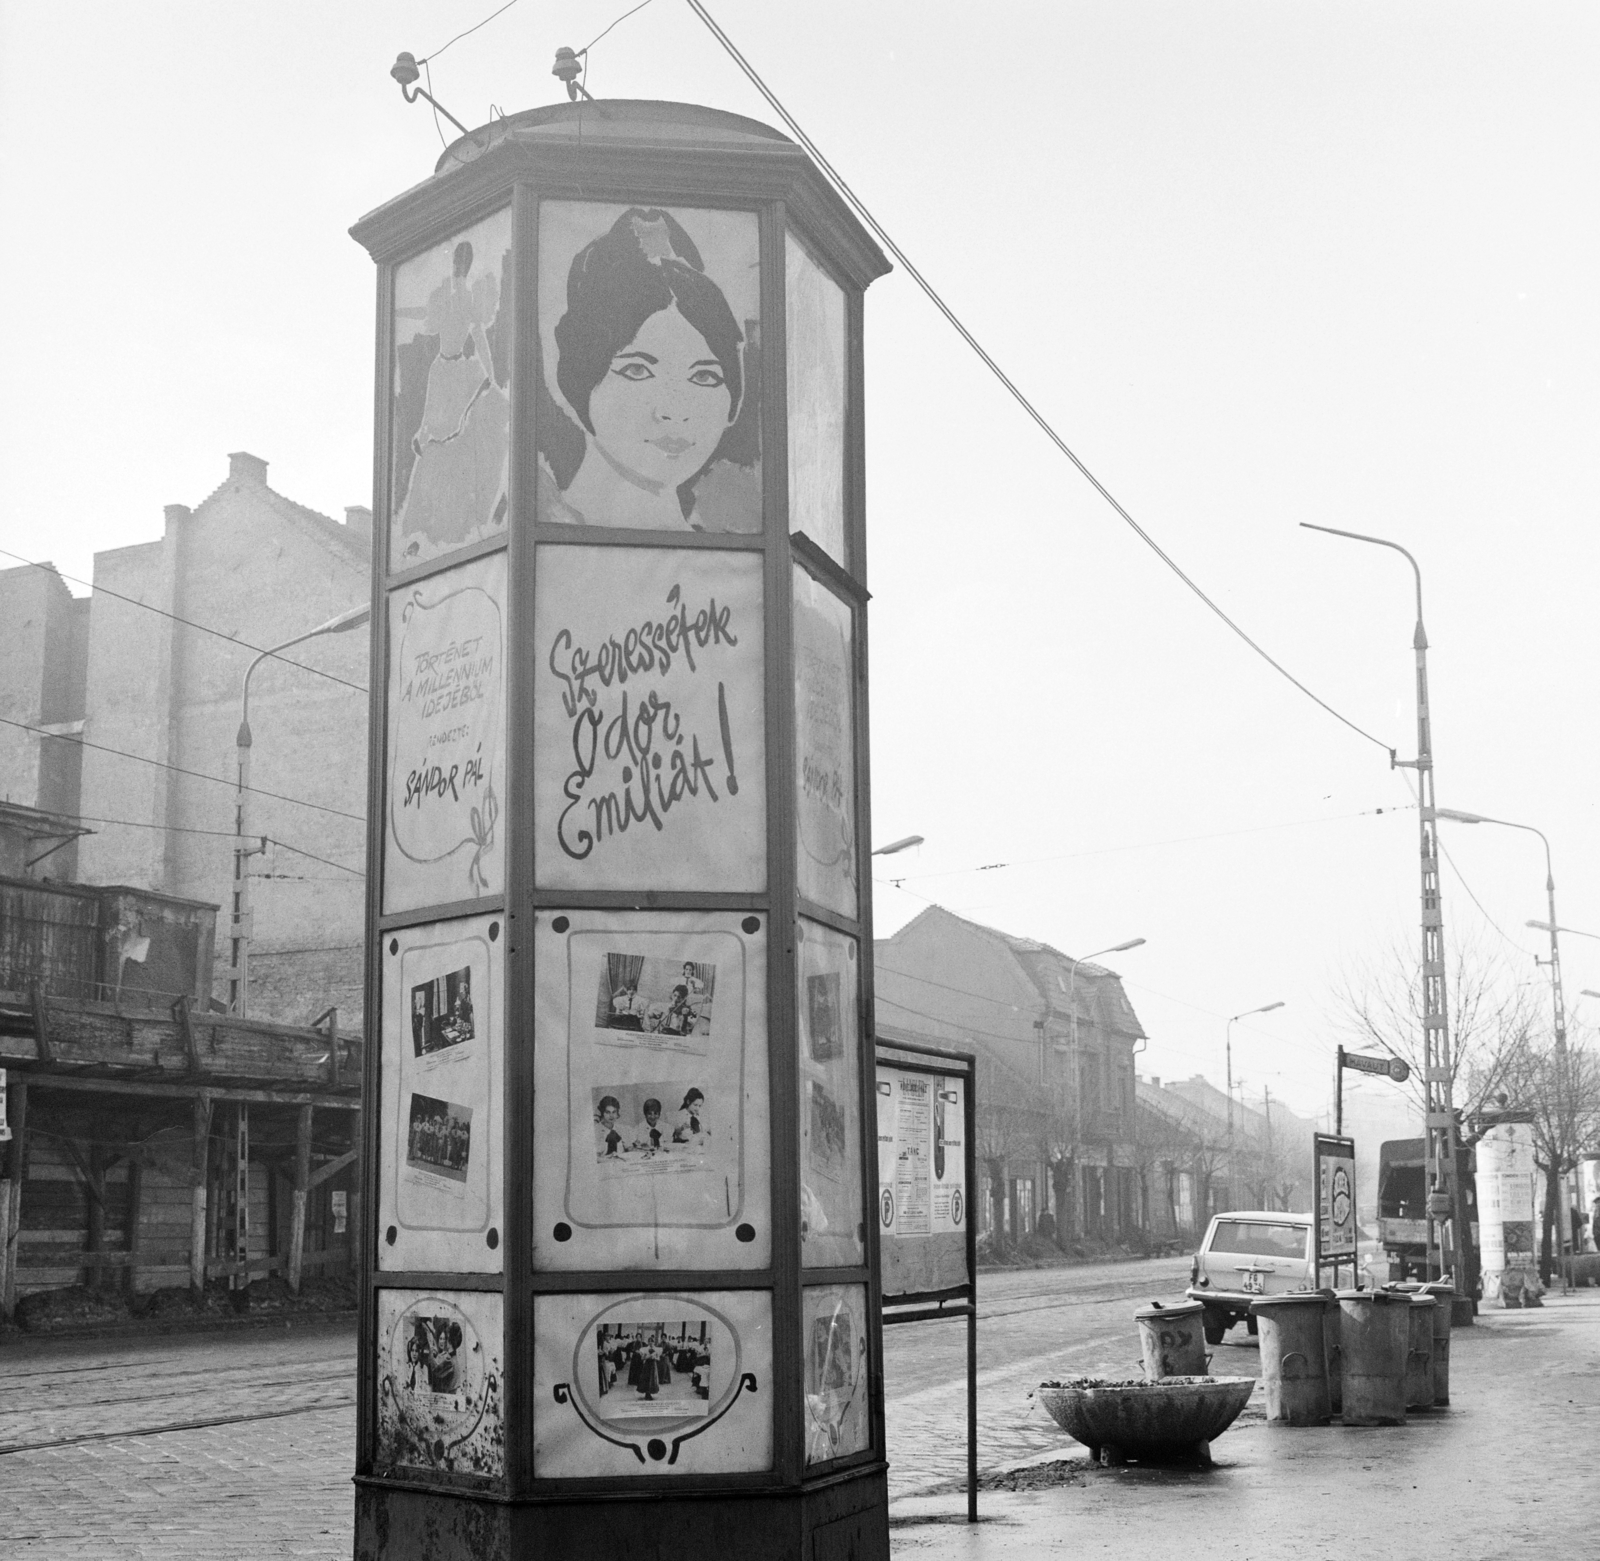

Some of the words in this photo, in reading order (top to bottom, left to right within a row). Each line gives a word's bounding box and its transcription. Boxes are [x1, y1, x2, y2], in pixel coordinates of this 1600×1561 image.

[401, 680, 413, 703] A
[415, 656, 493, 698] MILLENNIUM
[549, 583, 738, 718] Szeressétek
[403, 757, 459, 810] SÁNDOR
[462, 742, 484, 789] PÁL
